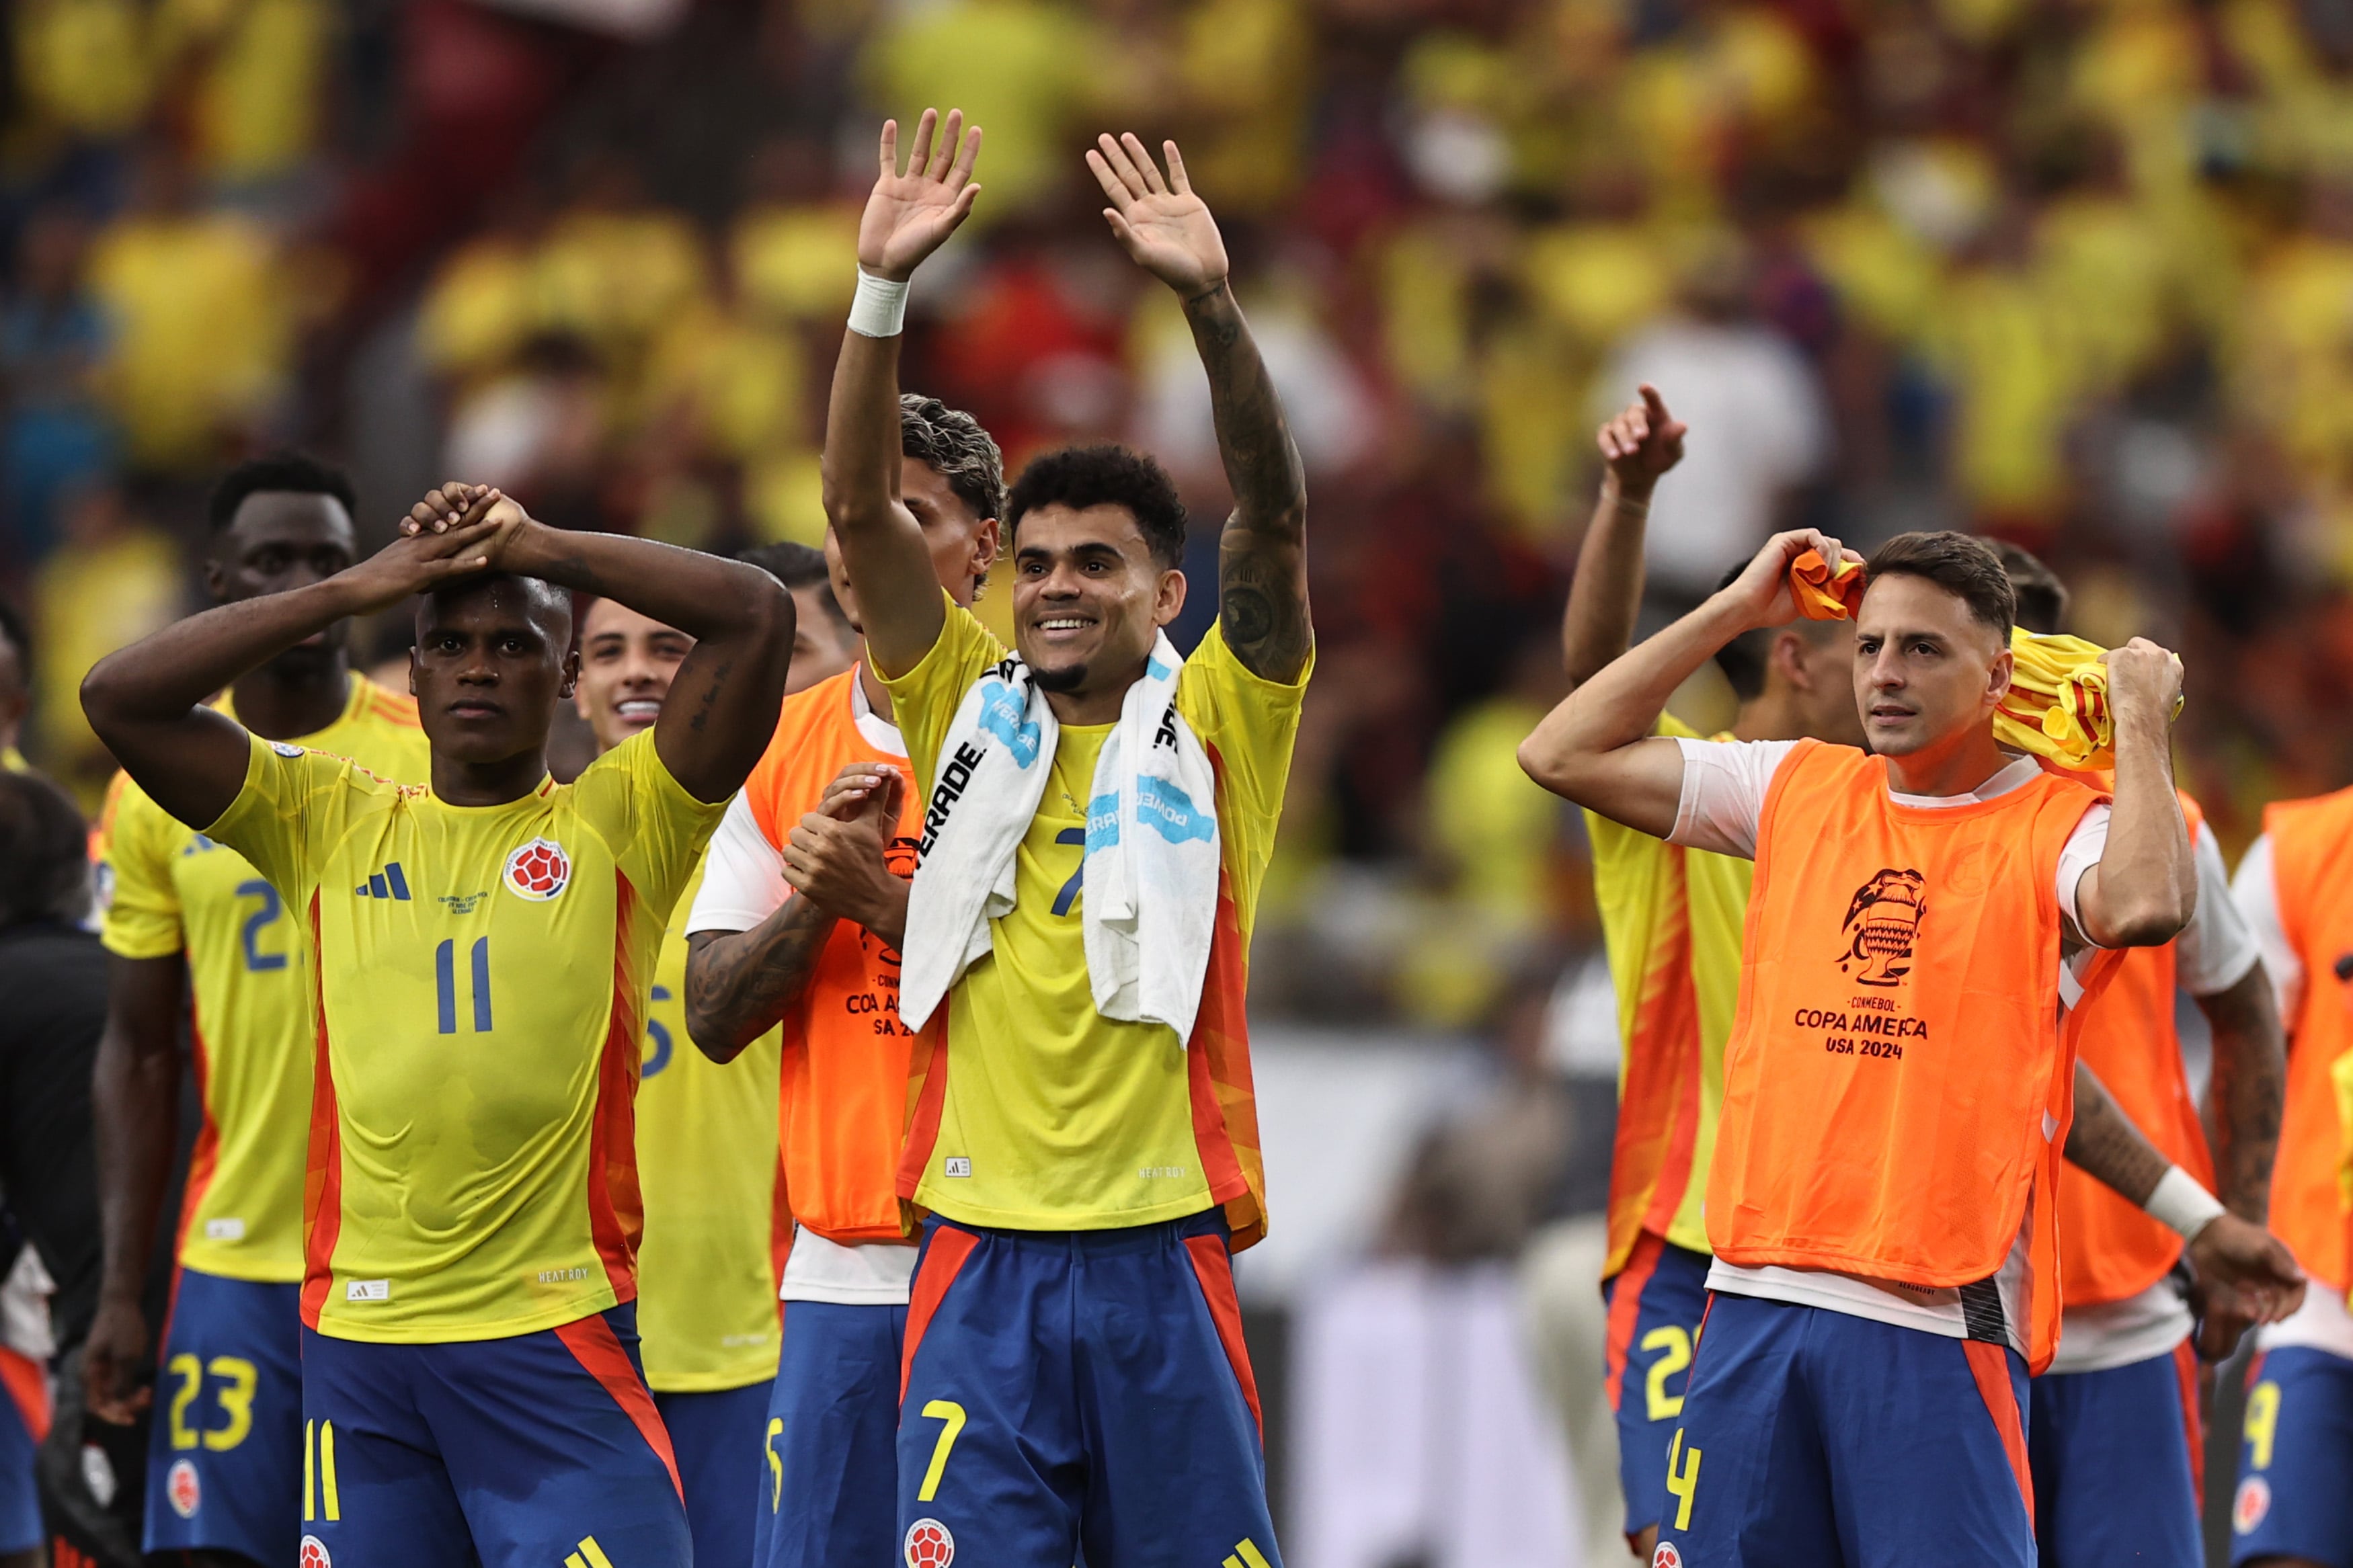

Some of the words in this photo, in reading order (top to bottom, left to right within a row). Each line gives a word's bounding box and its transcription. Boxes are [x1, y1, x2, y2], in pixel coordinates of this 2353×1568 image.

[916, 741, 988, 870] ERADE.
[1050, 827, 1086, 917] 7
[237, 878, 305, 971] 2
[436, 935, 493, 1034] 11
[846, 993, 879, 1014] COA
[873, 1018, 896, 1036] SA
[1794, 1008, 1847, 1032] COPA
[1850, 1014, 1928, 1040] AMERCA
[1825, 1036, 1855, 1055] USA
[1859, 1039, 1903, 1061] 2024
[169, 1352, 260, 1452] 23
[1640, 1323, 1702, 1422] 2
[304, 1417, 340, 1522] 11
[916, 1399, 967, 1502] 7
[2243, 1380, 2282, 1471] 9
[1666, 1427, 1702, 1532] 4
